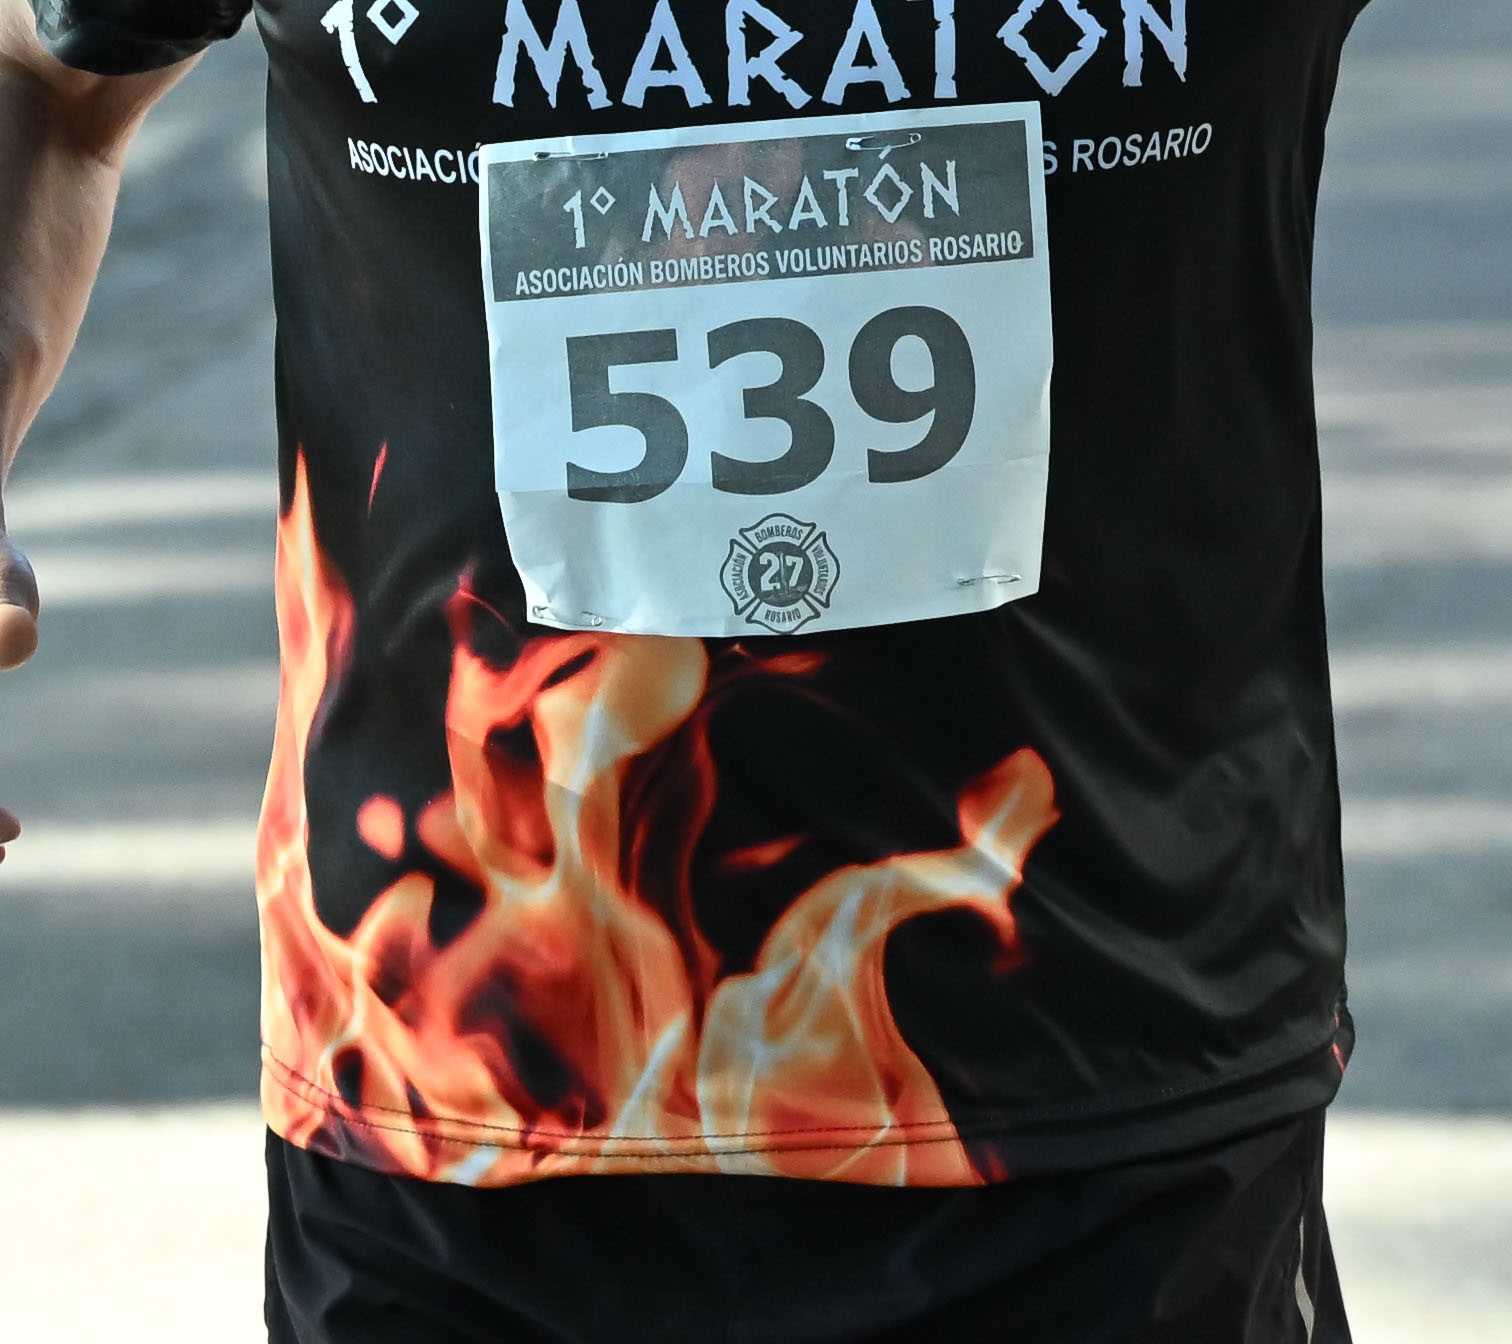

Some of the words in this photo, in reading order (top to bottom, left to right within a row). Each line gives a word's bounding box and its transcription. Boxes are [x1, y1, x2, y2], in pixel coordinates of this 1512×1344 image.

[347, 137, 480, 185] ASOCIACIÓ
[1072, 123, 1213, 174] ROSARIO
[641, 145, 960, 242] MARATÓN
[515, 257, 644, 296] ASOCIACIÓN
[650, 250, 771, 284] BOMBEROS
[775, 239, 923, 274] VOLUNTARIOS
[928, 230, 1023, 262] ROSARIO
[565, 305, 977, 504] 539
[754, 524, 804, 543] BOMBEROS
[759, 552, 804, 591] 27
[764, 607, 802, 623] ROSARIO
